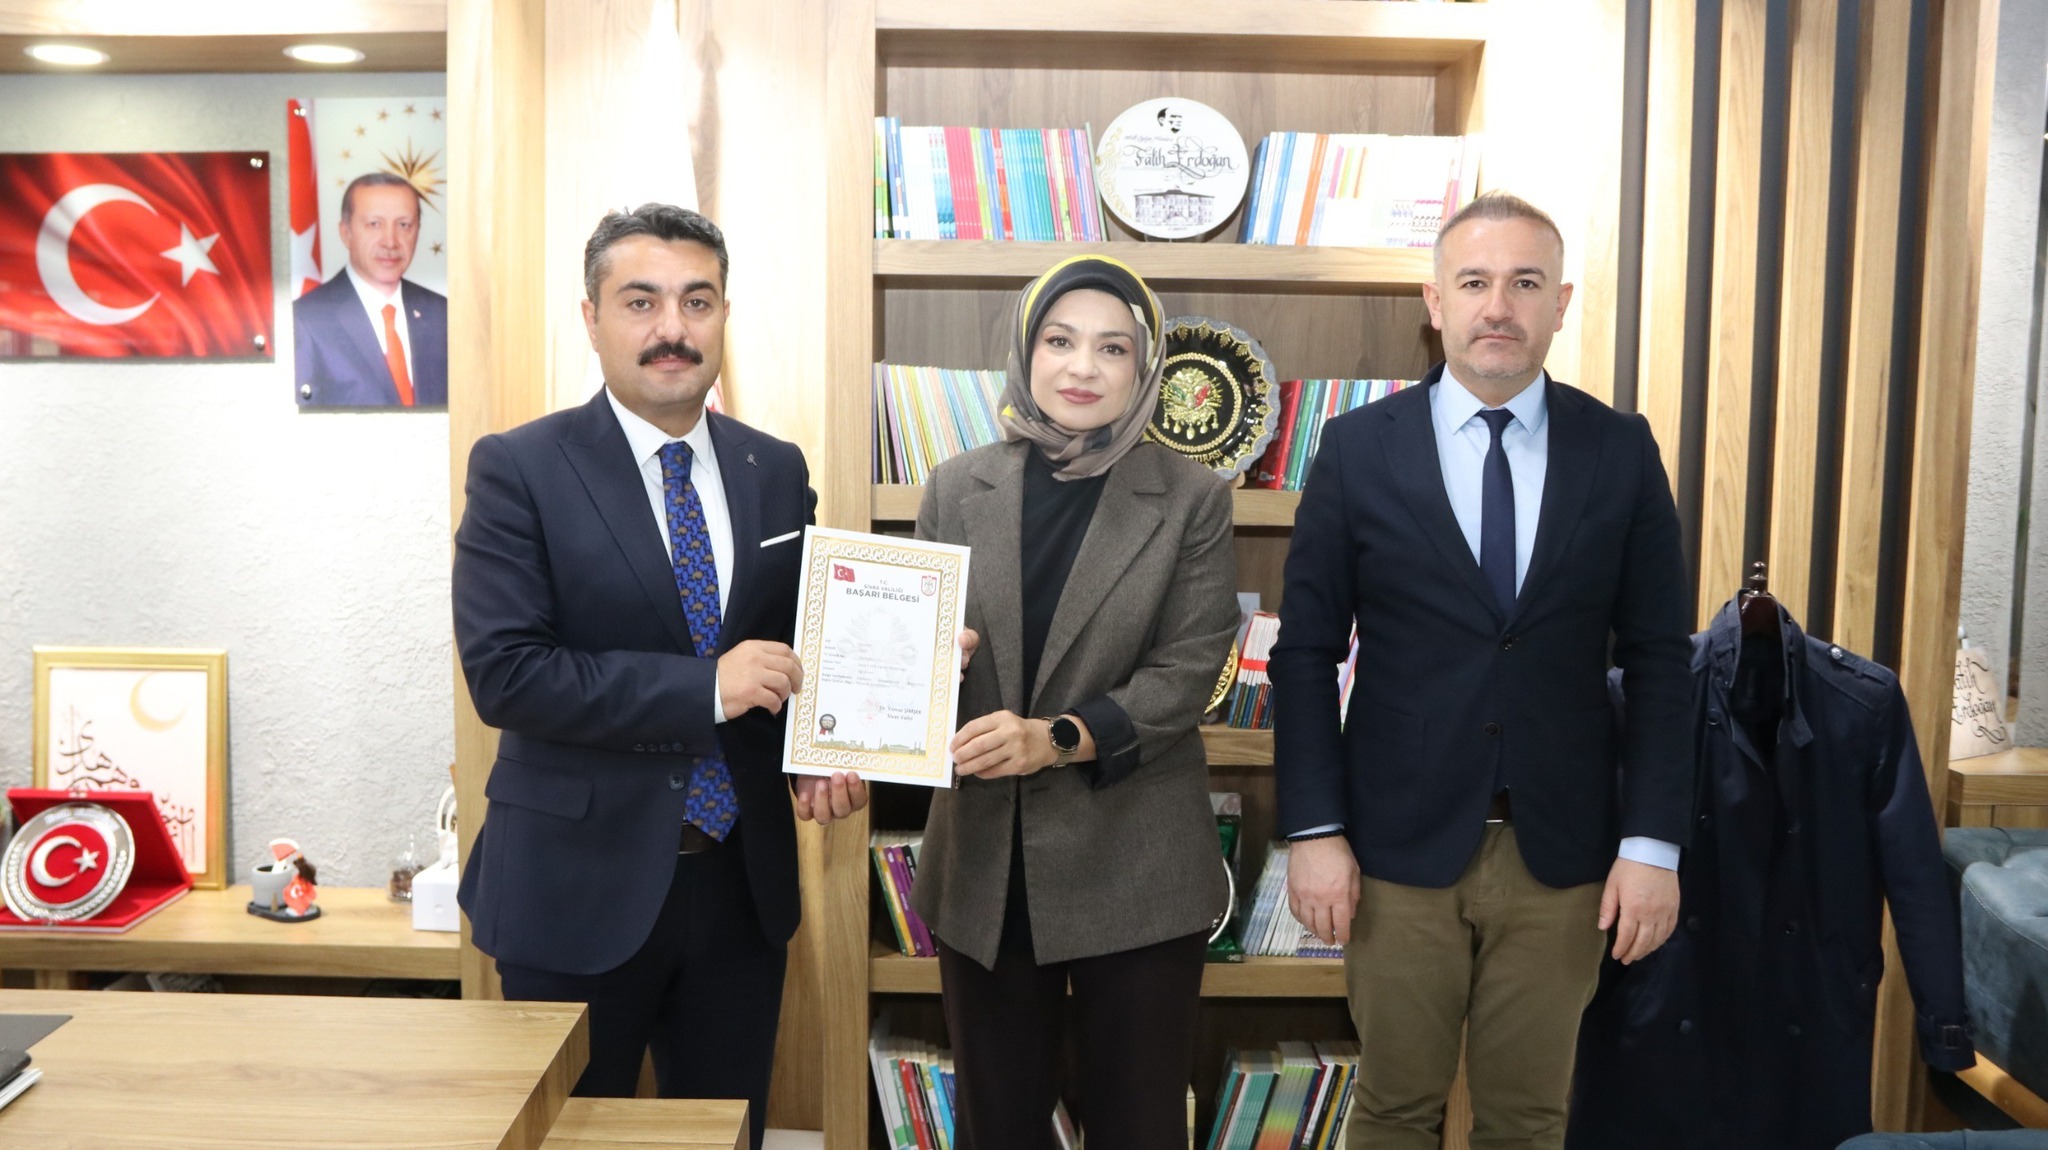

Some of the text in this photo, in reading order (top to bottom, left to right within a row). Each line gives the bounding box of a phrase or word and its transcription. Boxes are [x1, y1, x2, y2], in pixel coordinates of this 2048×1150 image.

[1124, 138, 1237, 179] Fatih Erdoğan
[846, 587, 920, 603] BAŞARI BELGESİ
